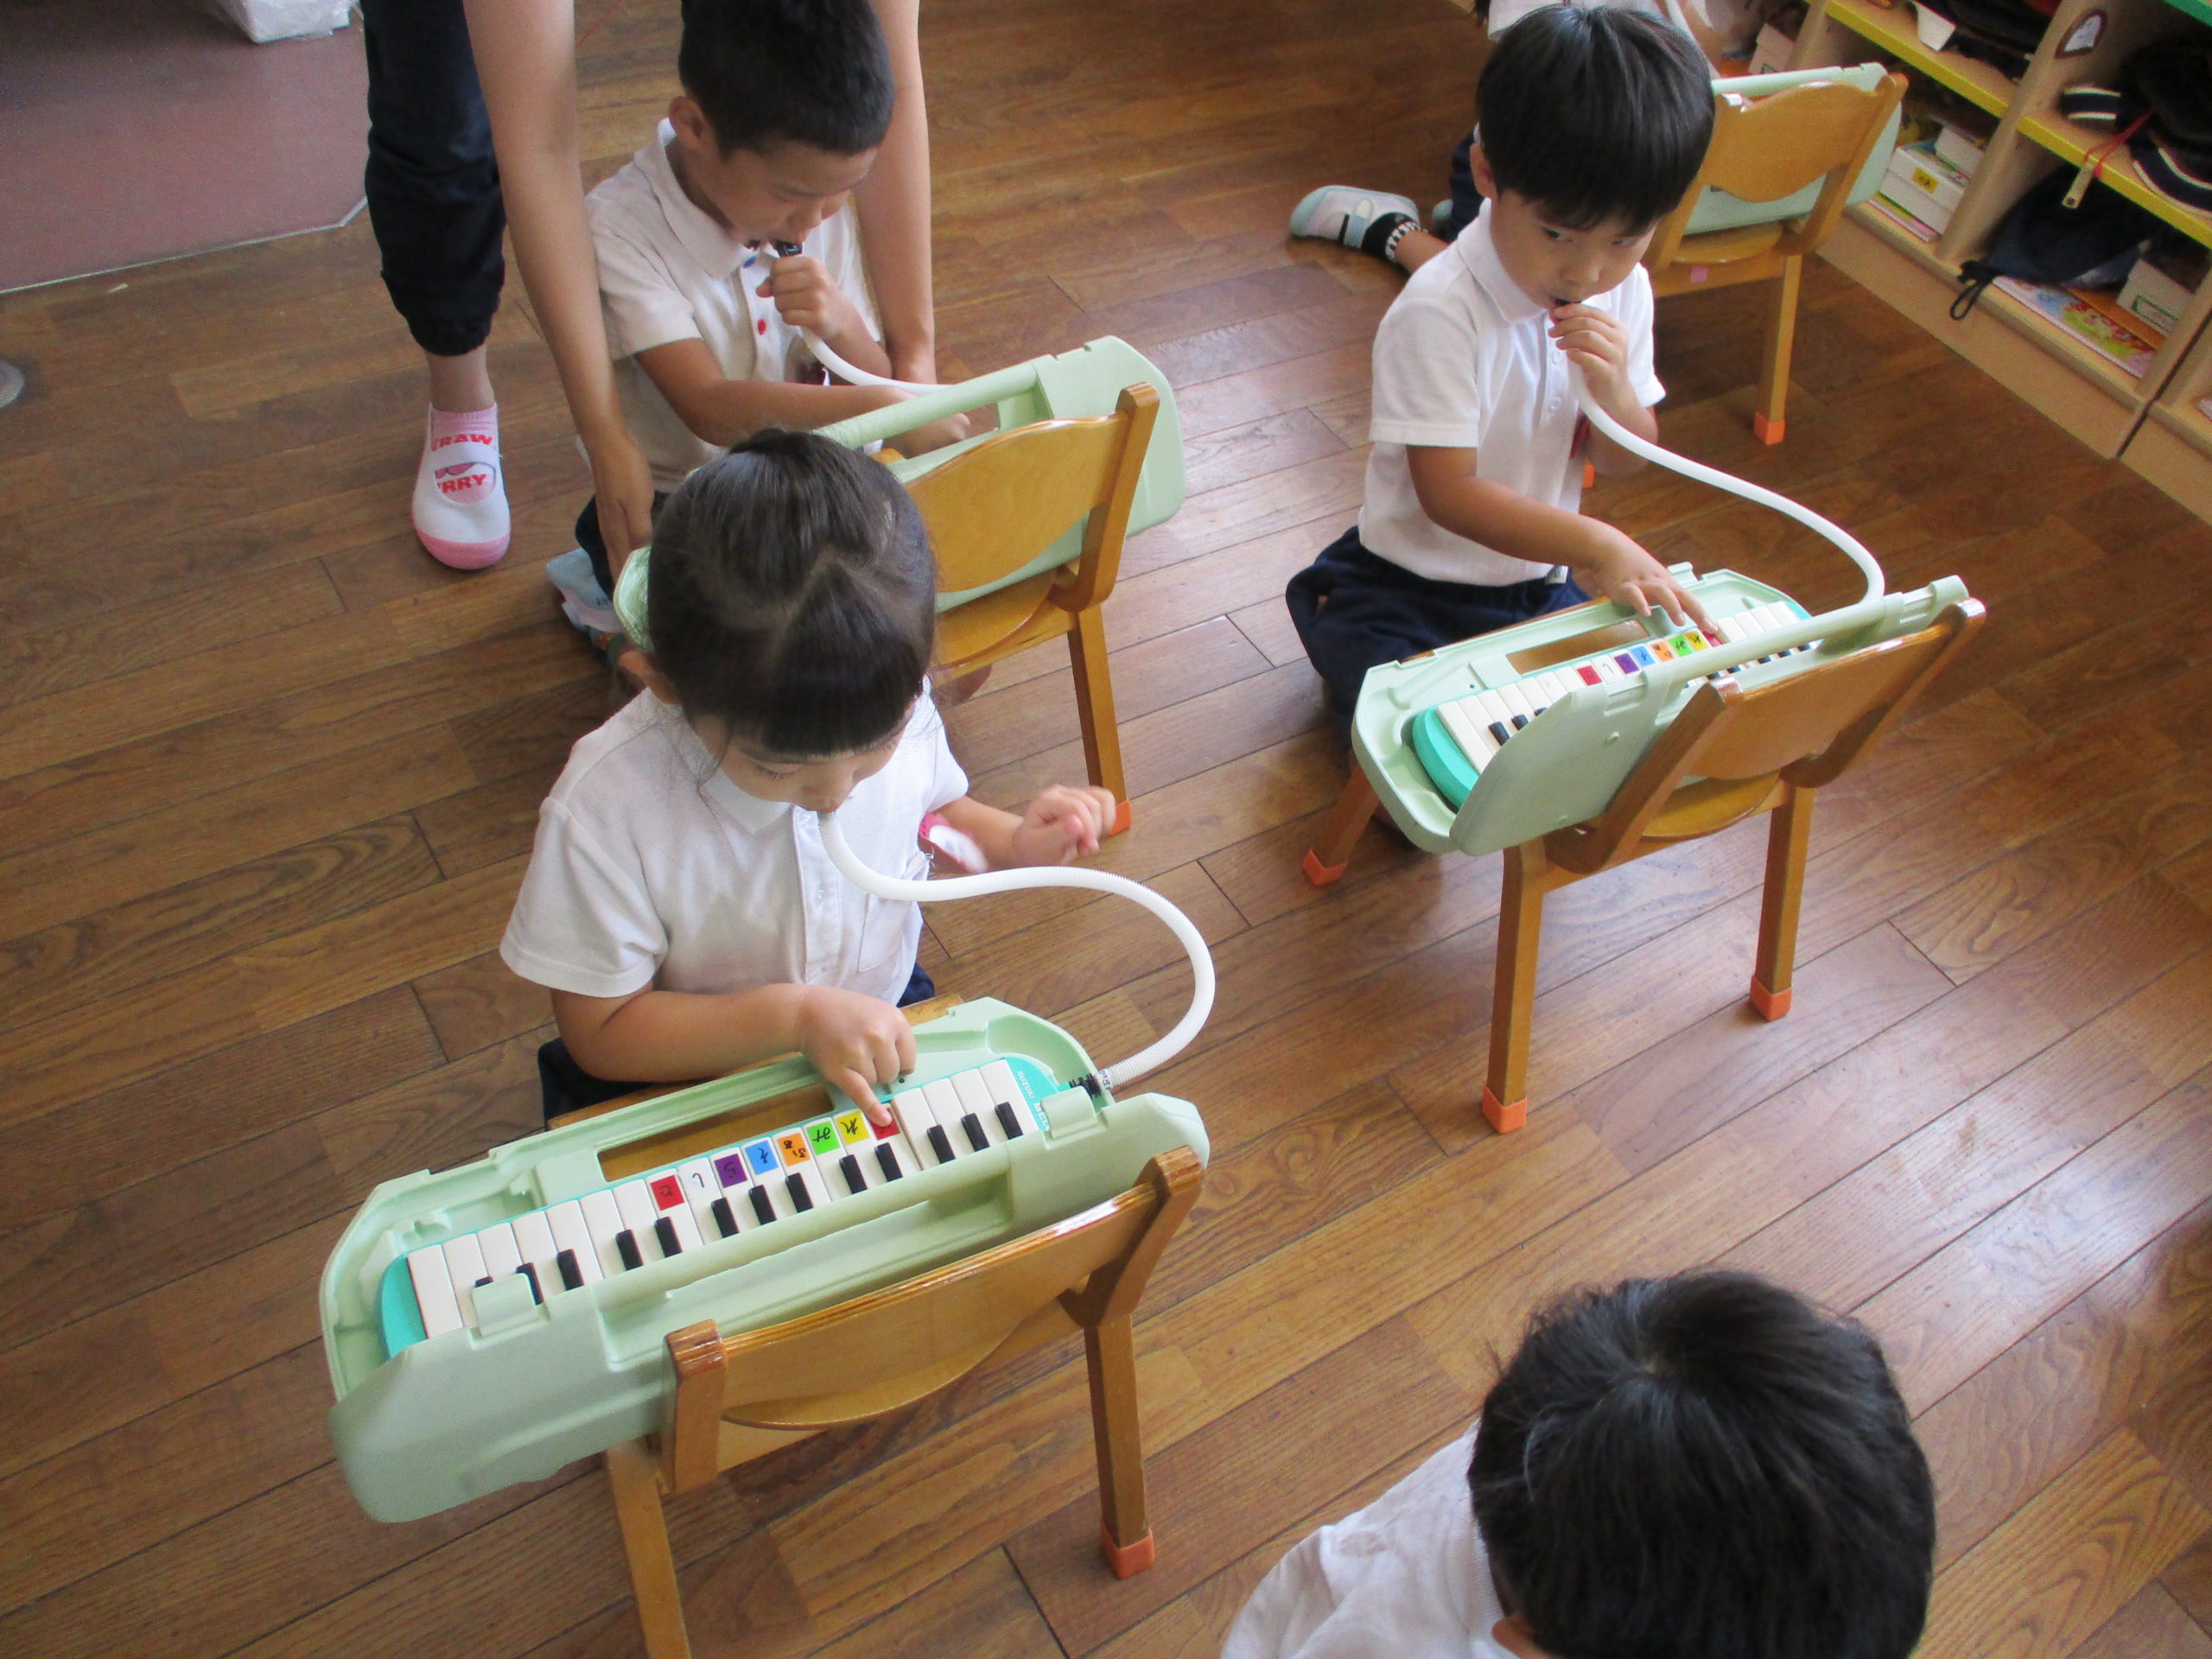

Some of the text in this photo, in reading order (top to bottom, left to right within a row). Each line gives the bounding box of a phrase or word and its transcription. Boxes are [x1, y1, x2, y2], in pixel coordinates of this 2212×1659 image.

[437, 474, 487, 493] RRY
[1017, 1071, 1035, 1100] SUZUKI
[812, 1127, 831, 1142] み
